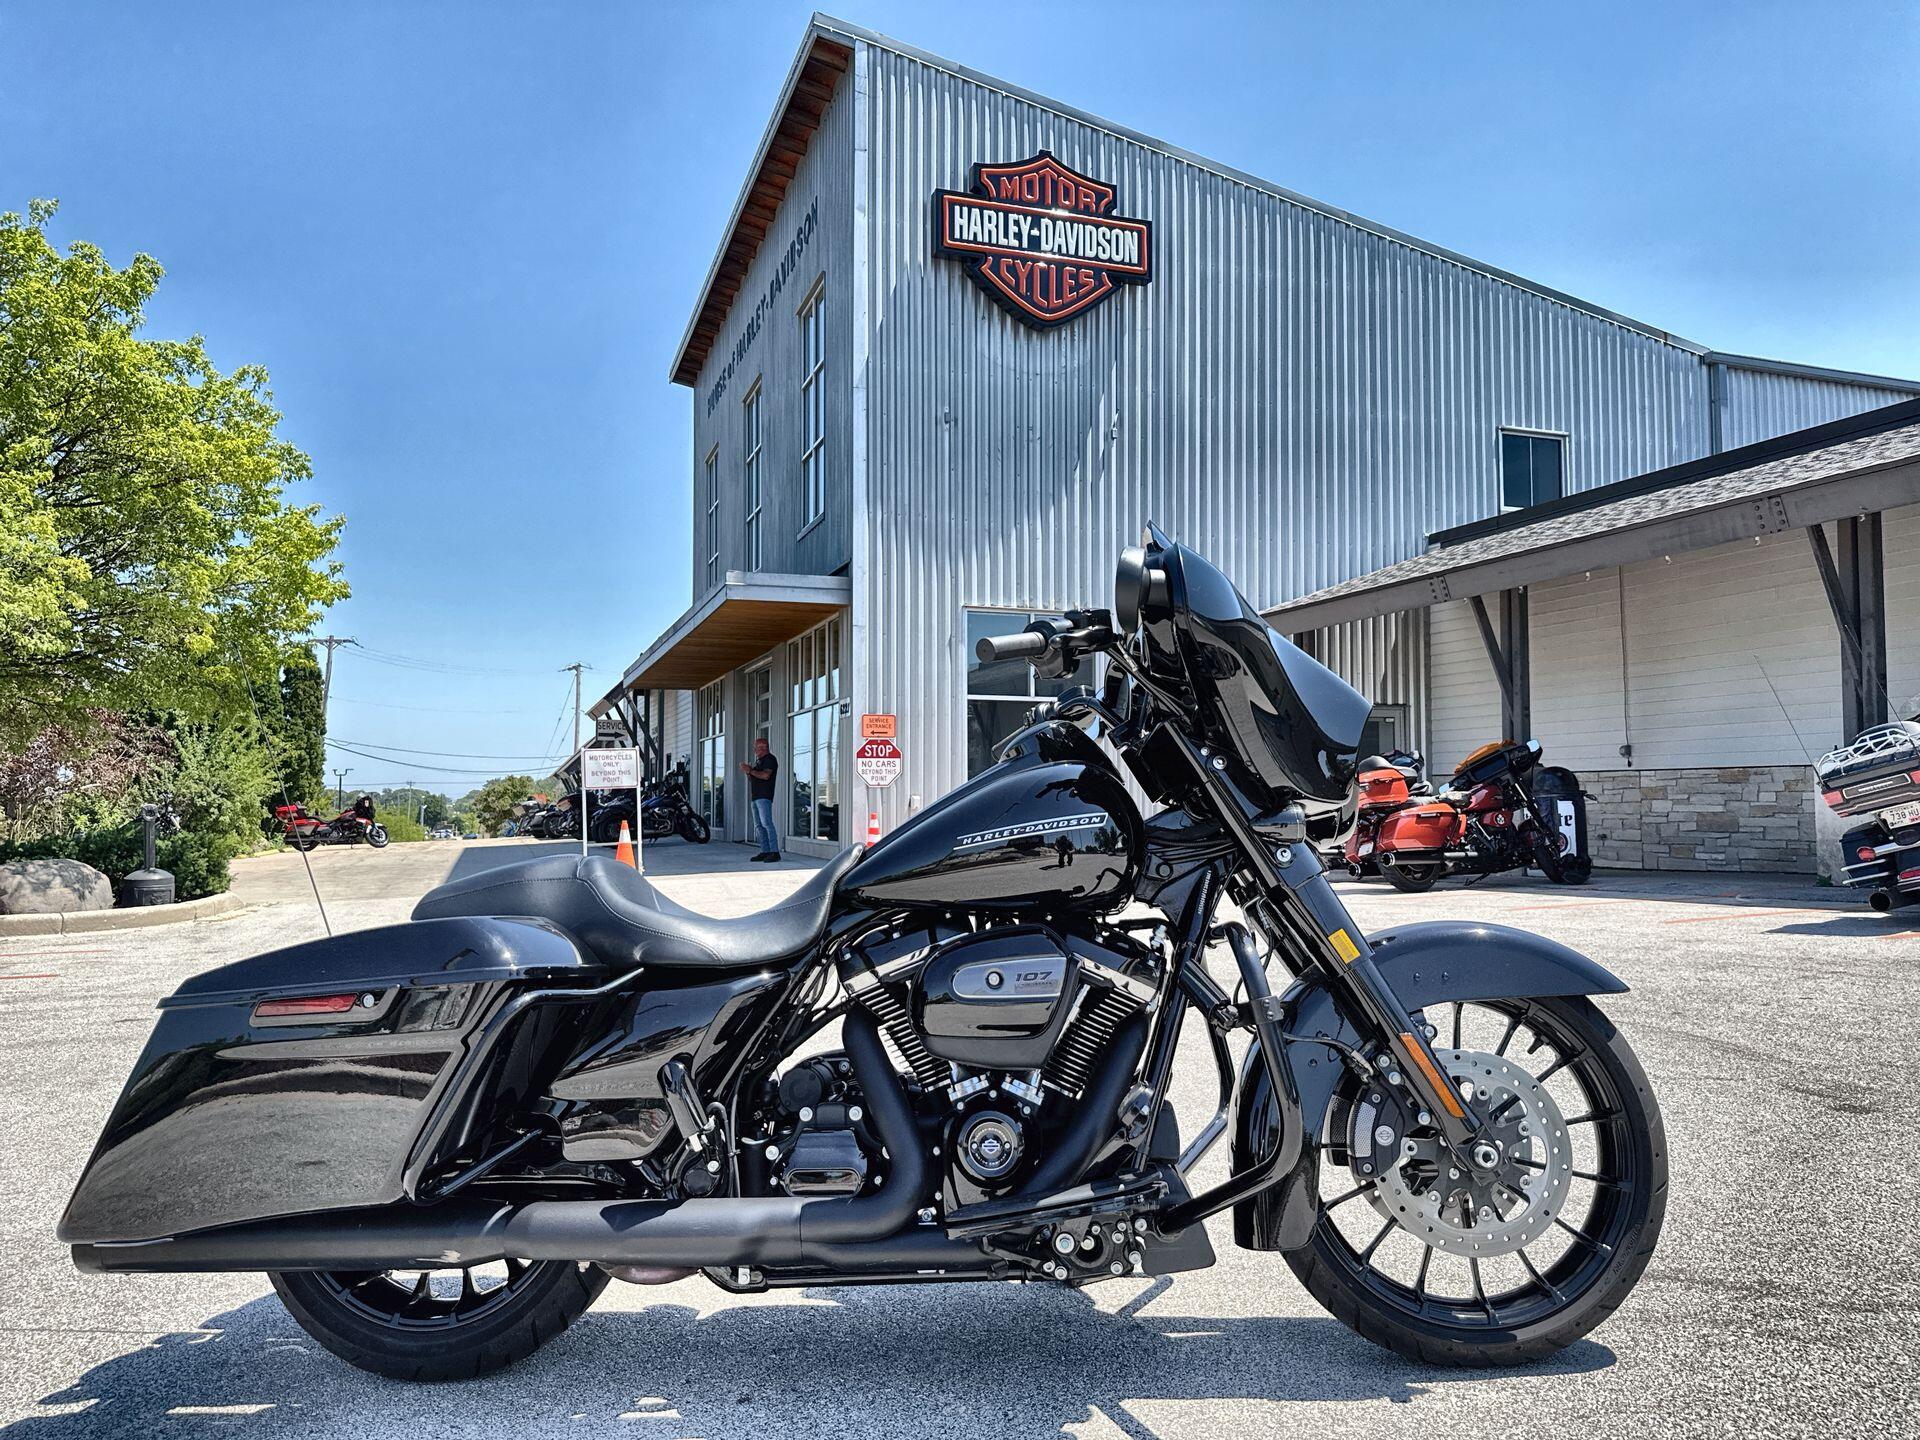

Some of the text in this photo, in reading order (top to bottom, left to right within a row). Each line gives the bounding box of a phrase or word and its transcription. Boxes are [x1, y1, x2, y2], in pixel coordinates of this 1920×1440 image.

[999, 168, 1096, 213] MOTOR
[953, 205, 1139, 265] HARLEY-DAVIDSON
[999, 258, 1095, 309] CYCLES
[861, 760, 897, 768] NO CARS
[864, 744, 893, 757] STOP
[962, 816, 1102, 845] HARLEY-DAVIDSON
[1016, 971, 1053, 982] 107
